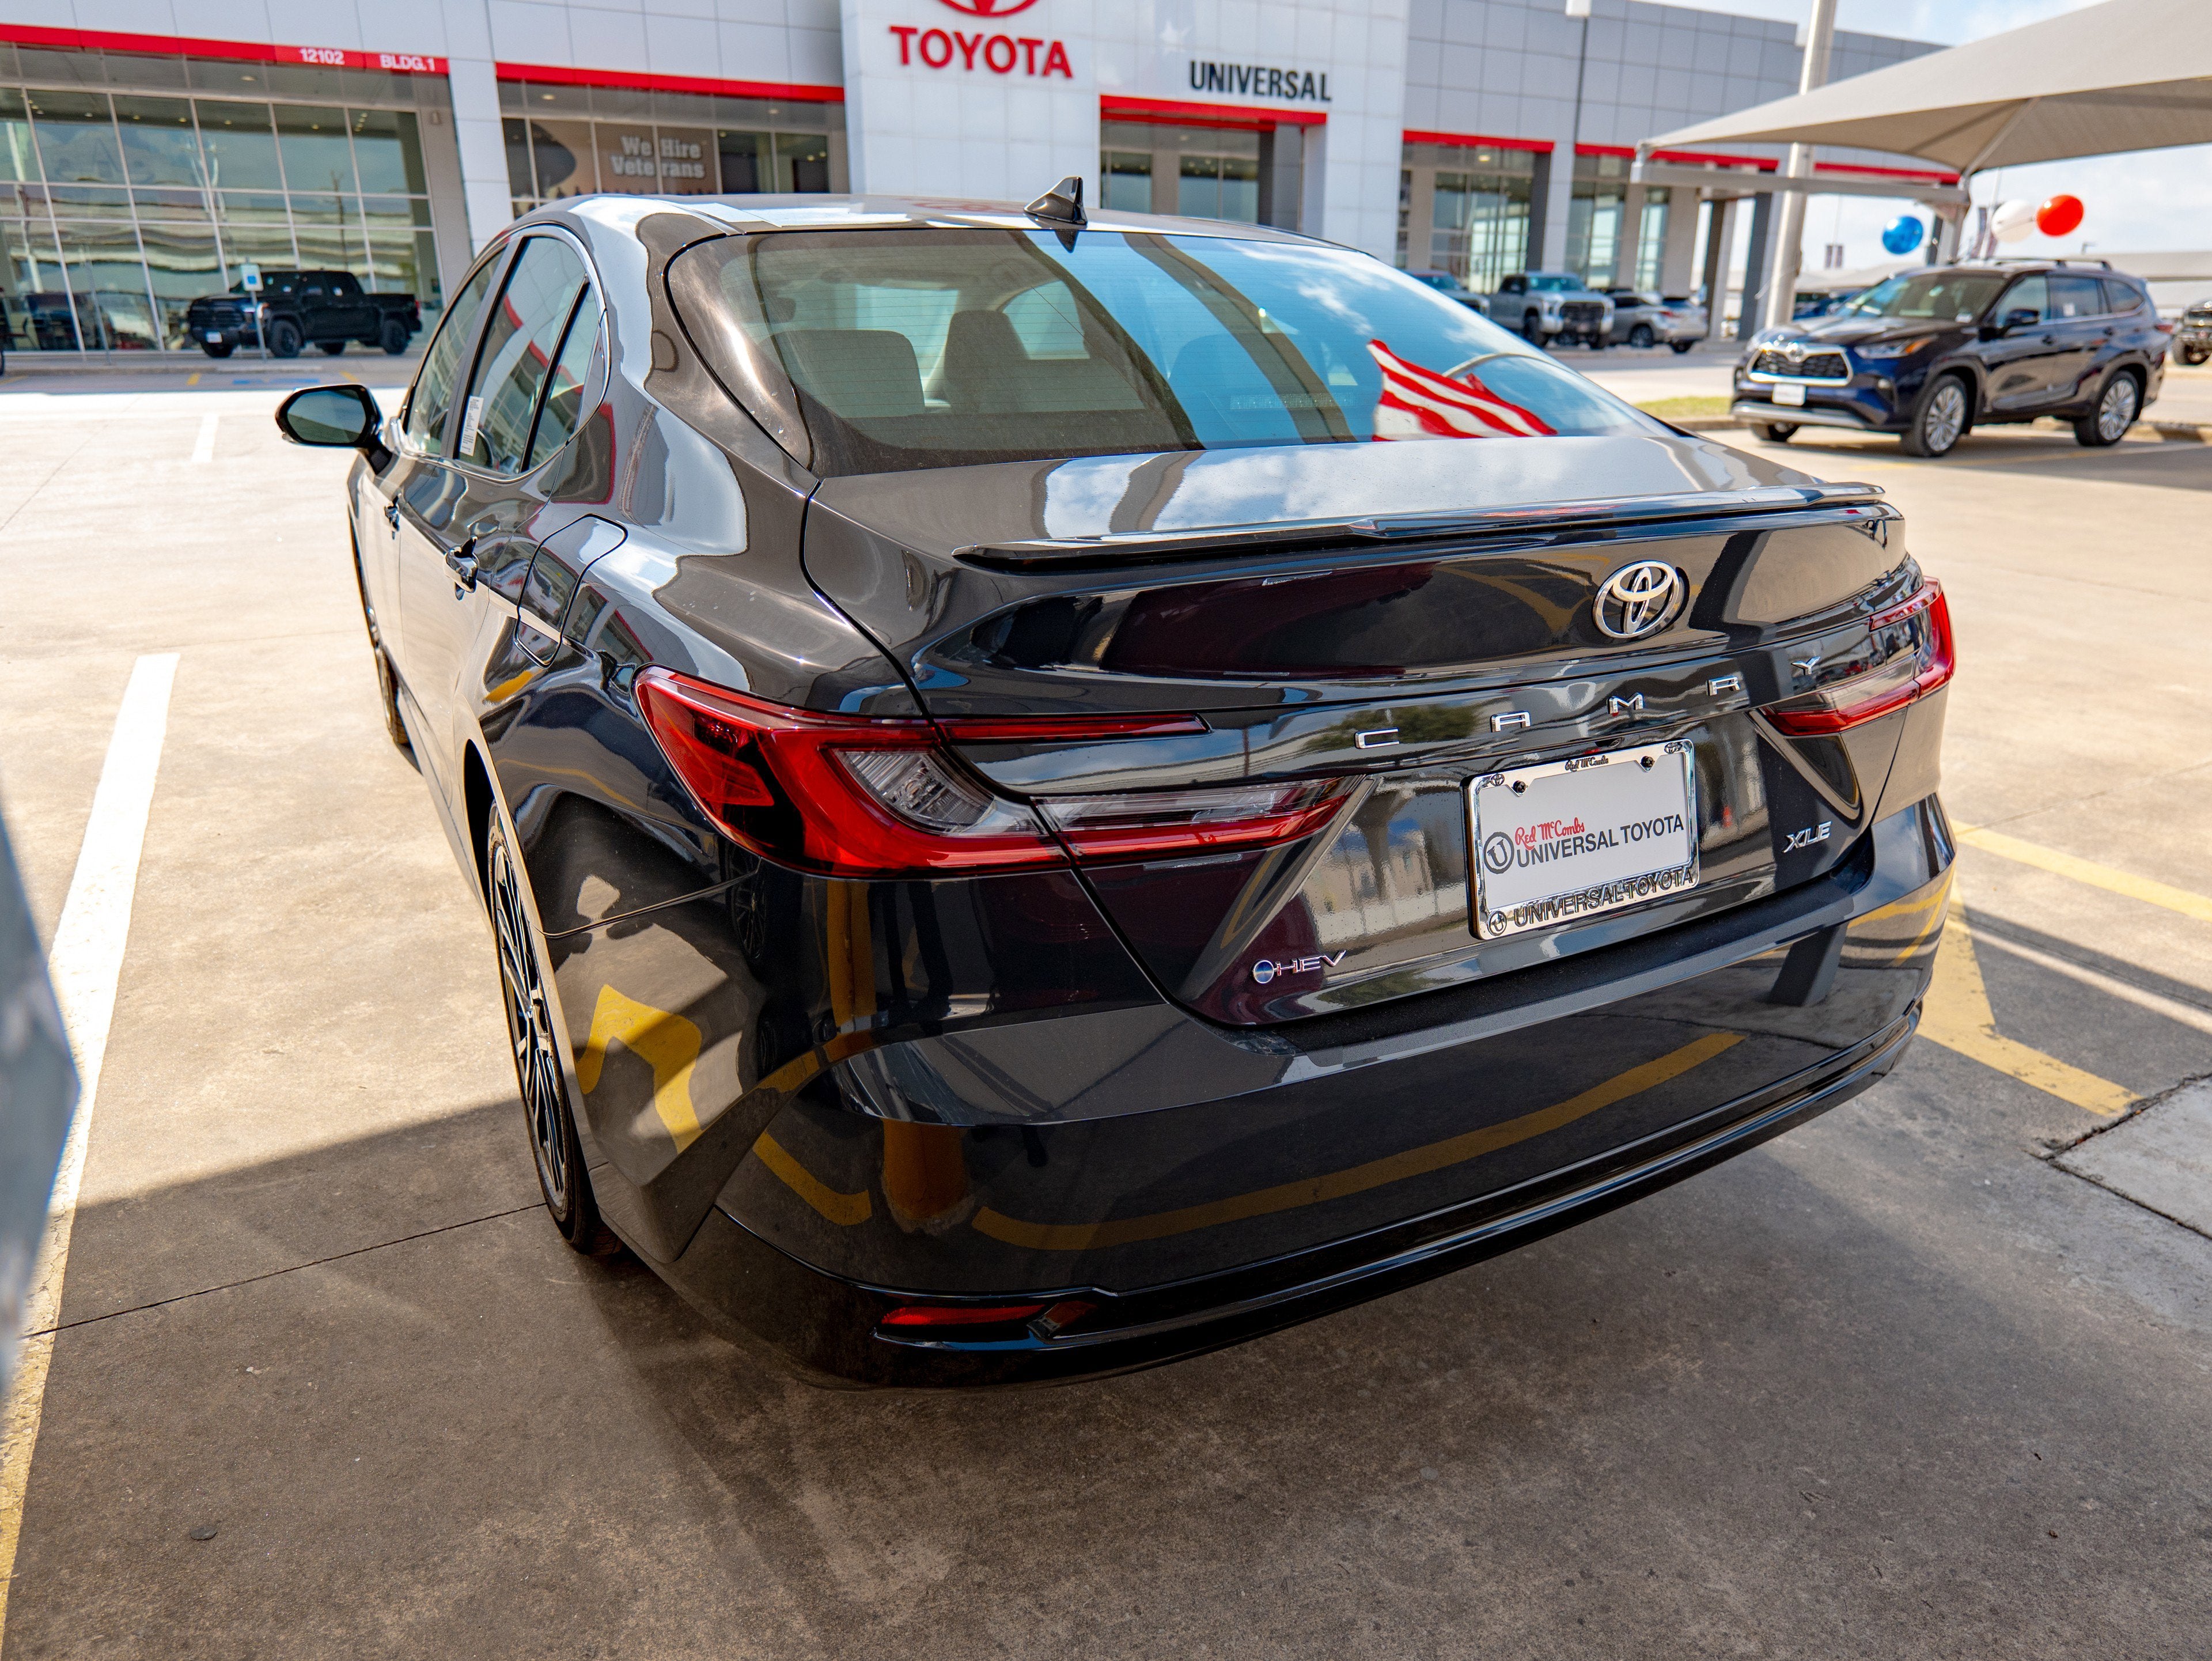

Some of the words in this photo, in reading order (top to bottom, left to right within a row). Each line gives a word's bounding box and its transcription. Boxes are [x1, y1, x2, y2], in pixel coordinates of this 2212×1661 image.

[300, 48, 344, 65] 12102
[889, 26, 1072, 78] TOYOTA
[1190, 60, 1332, 101] UNIVERSAL
[620, 136, 652, 156] We
[660, 138, 702, 159] Hire
[610, 154, 704, 179] Veterans
[1565, 759, 1580, 772] Red
[1515, 826, 1536, 851] Red
[1537, 817, 1585, 838] McCombs
[1517, 828, 1619, 868] UNIVERSAL
[1620, 814, 1684, 844] TOYOTA
[1782, 820, 1832, 853] XLE
[1514, 884, 1624, 927] UNIVERSAL
[1624, 867, 1694, 899] TOYOTA
